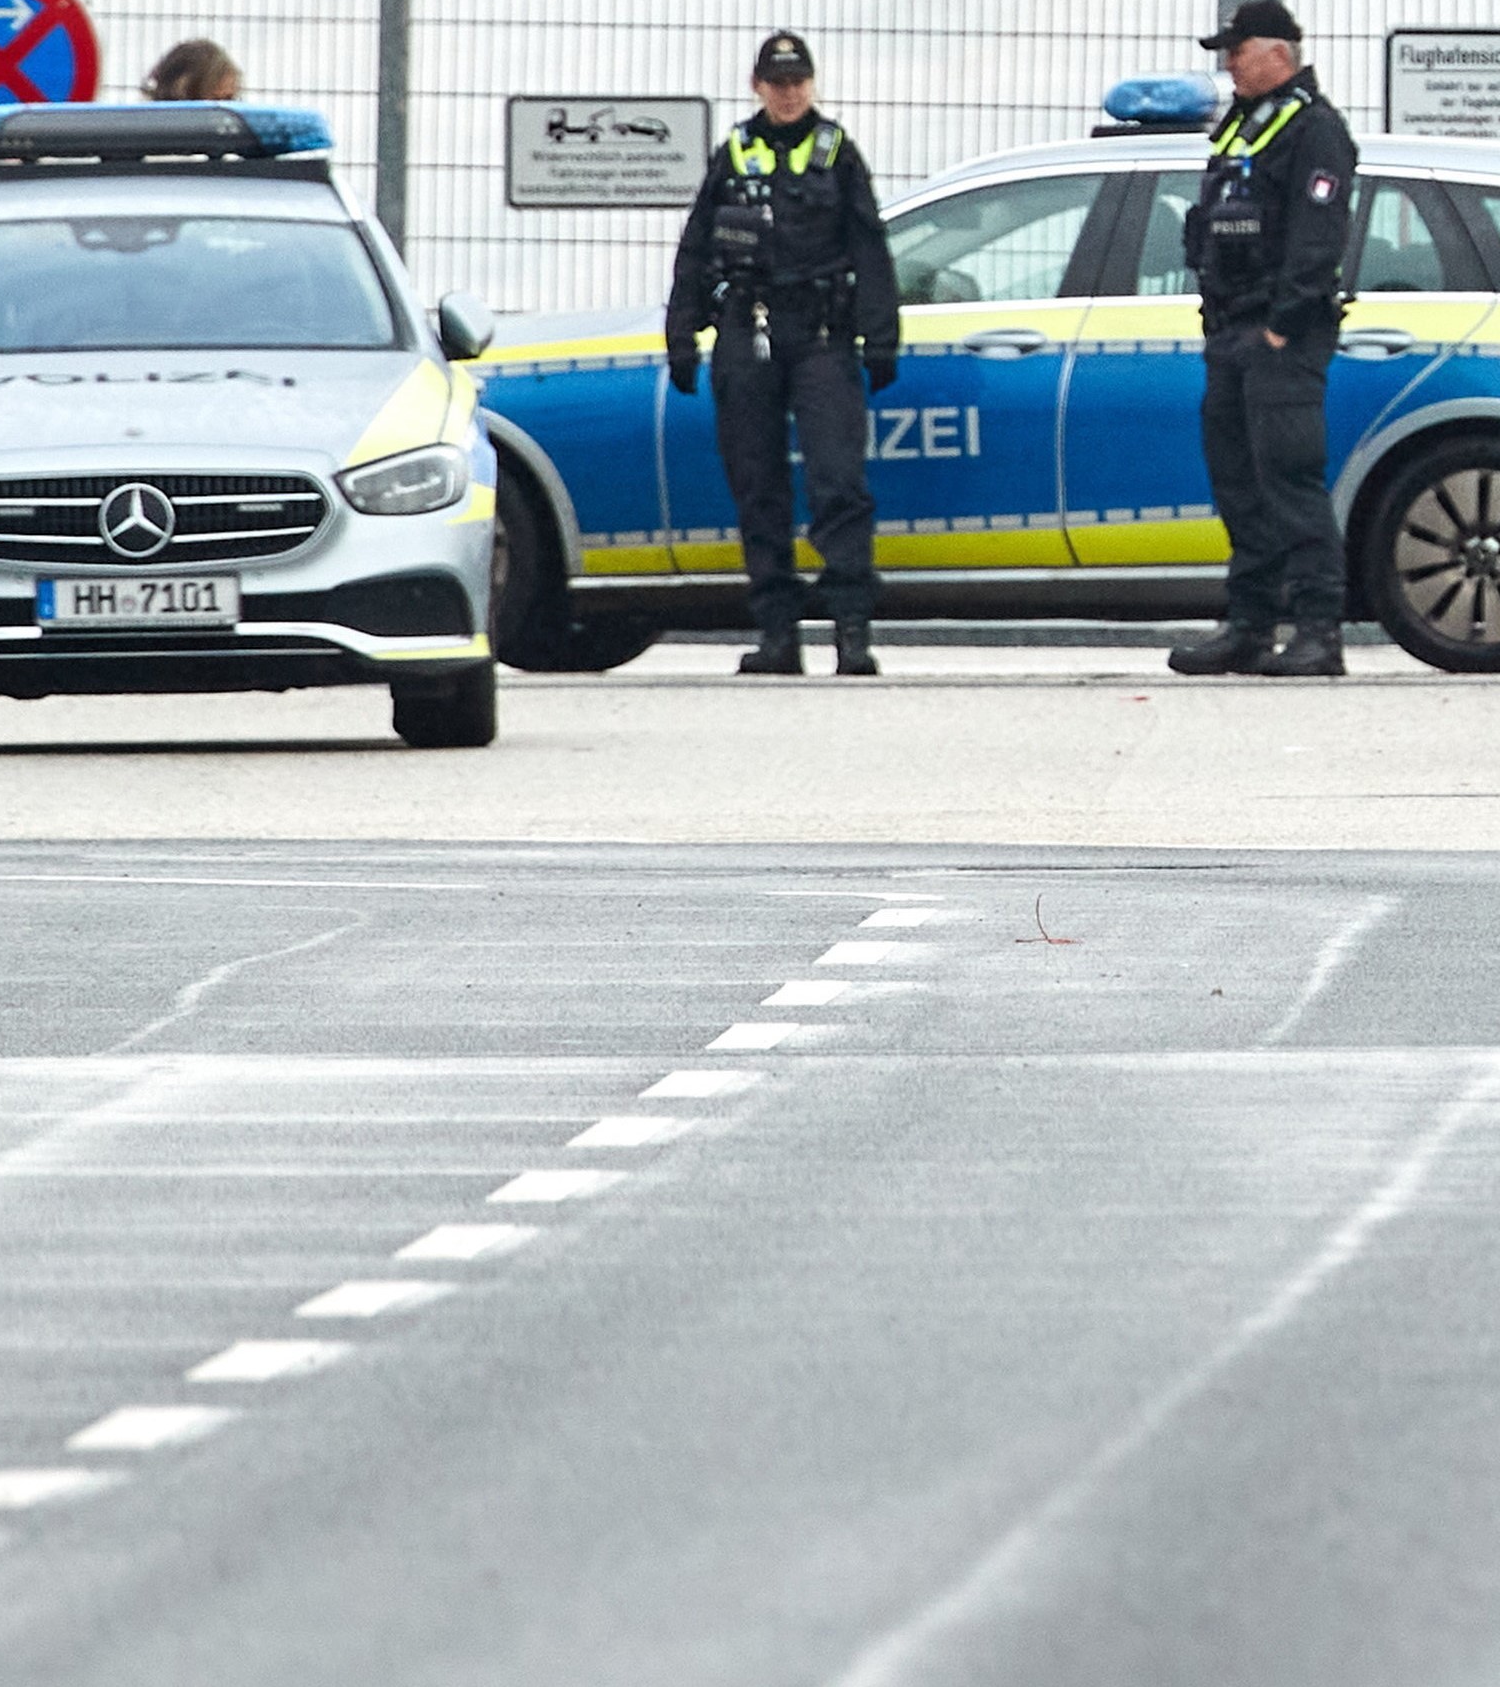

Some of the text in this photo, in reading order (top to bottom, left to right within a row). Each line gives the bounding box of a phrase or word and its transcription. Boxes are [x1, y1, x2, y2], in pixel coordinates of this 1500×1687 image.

[1211, 219, 1261, 234] POLIZEI
[73, 582, 220, 614] HH 7101
